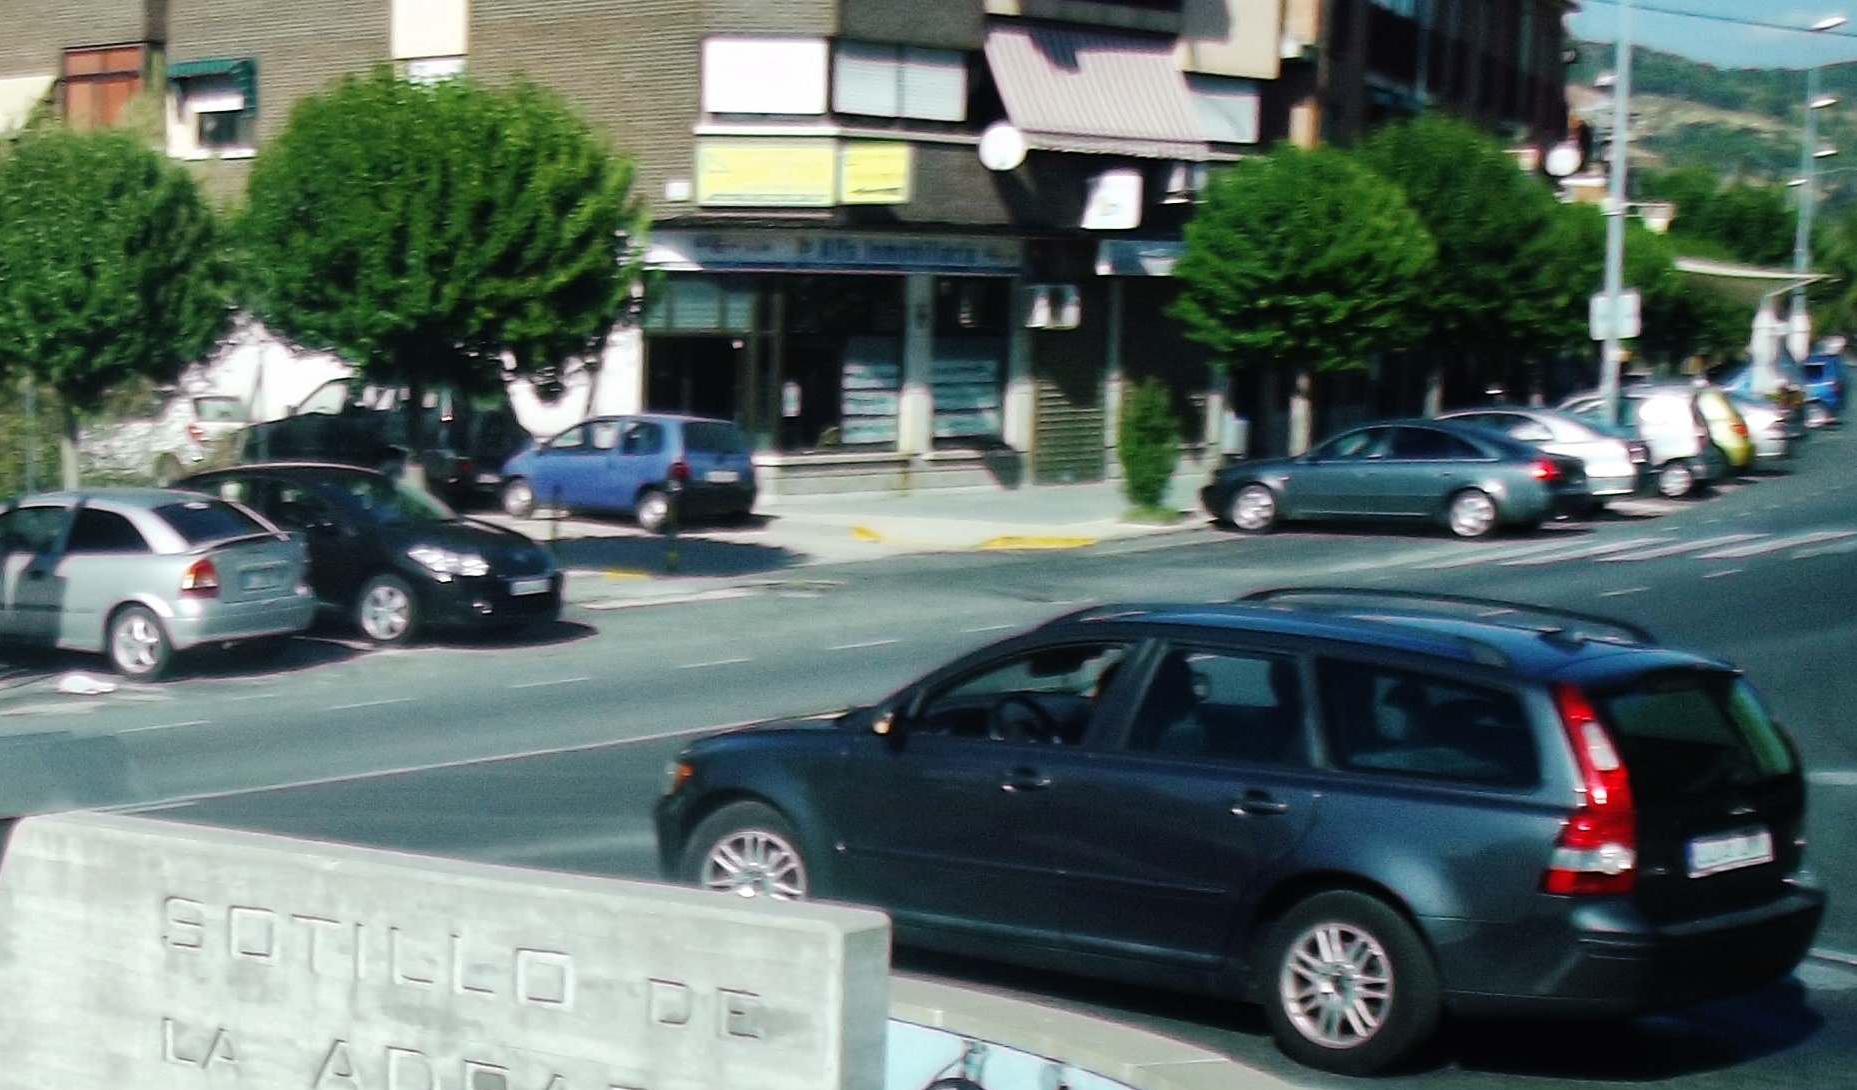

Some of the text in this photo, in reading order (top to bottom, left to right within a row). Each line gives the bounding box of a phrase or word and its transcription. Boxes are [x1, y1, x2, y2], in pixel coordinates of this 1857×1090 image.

[161, 895, 765, 1040] SOTILLO DE
[161, 1014, 241, 1074] LA
